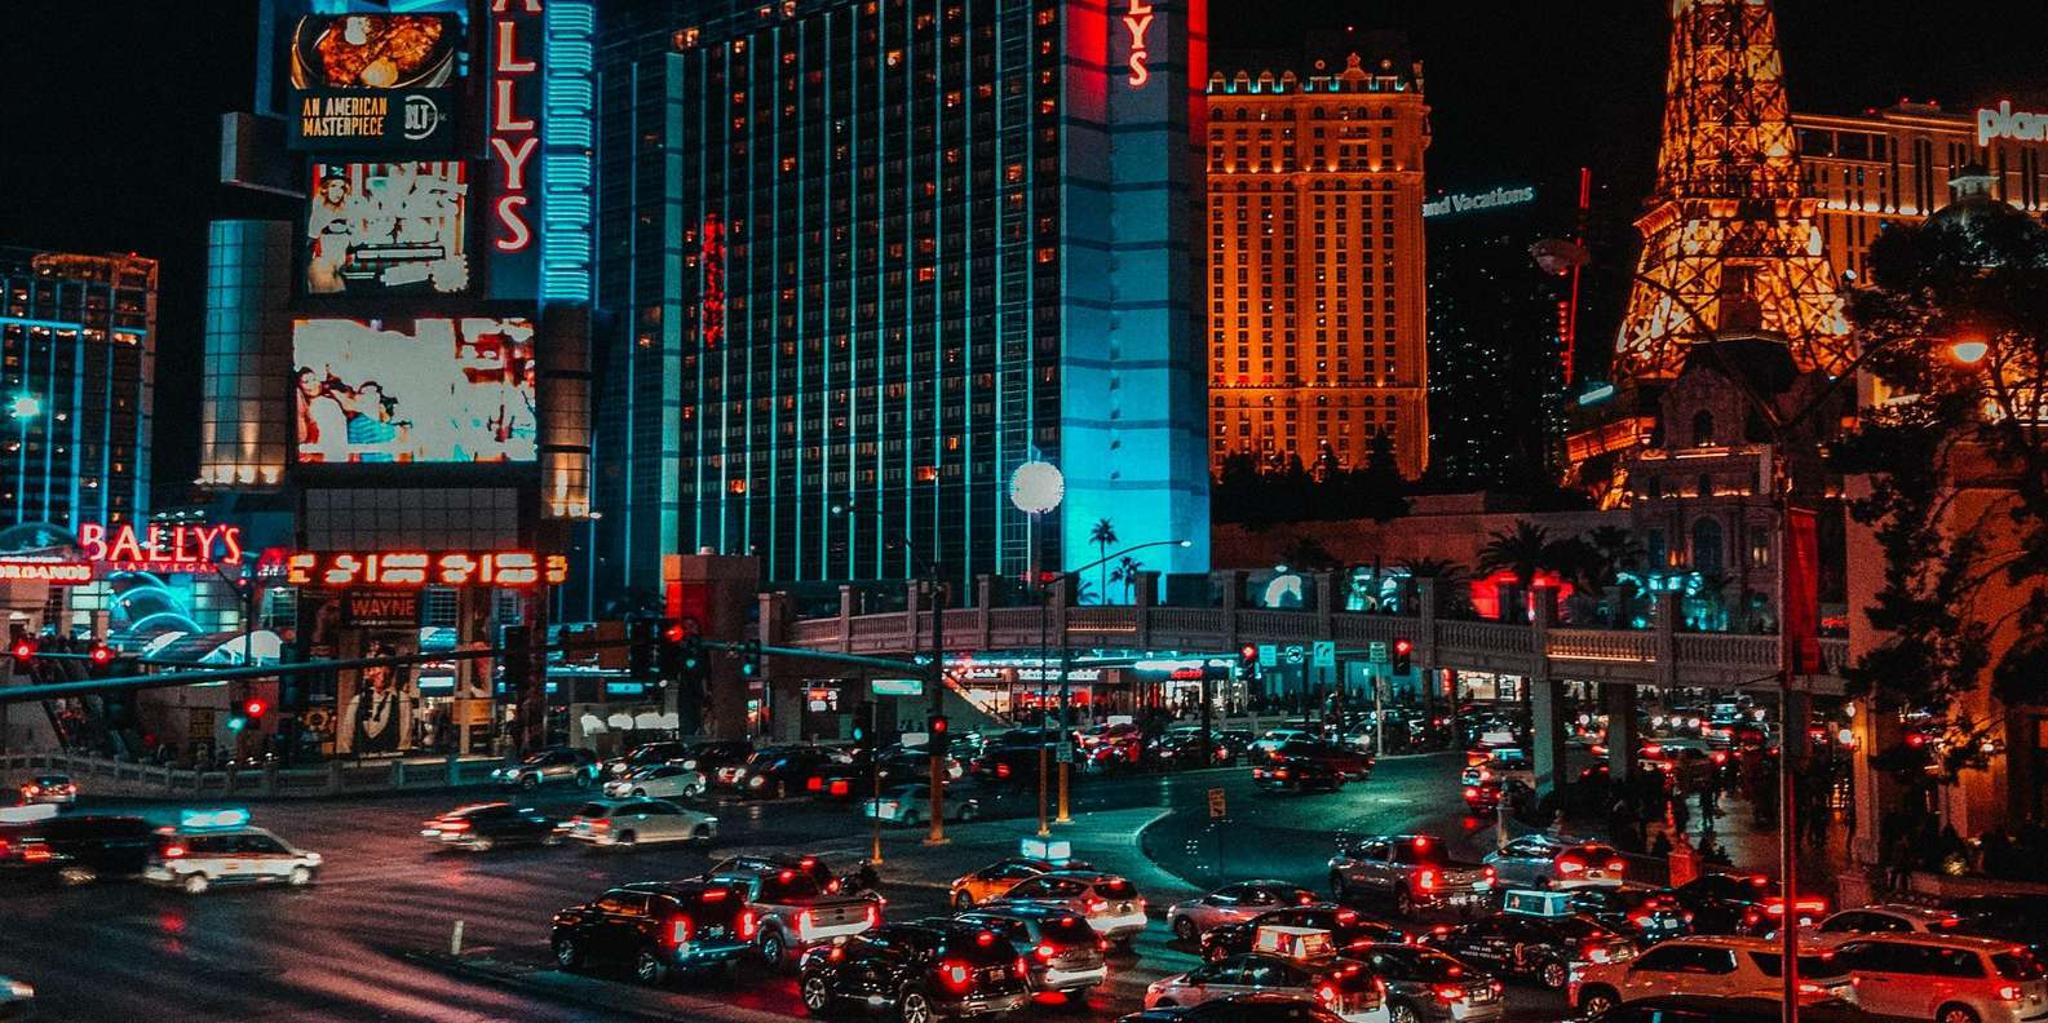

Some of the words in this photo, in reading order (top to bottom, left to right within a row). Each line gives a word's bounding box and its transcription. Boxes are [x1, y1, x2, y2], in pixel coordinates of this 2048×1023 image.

[303, 97, 321, 116] AN
[325, 97, 388, 116] AMERICAN
[303, 116, 385, 136] MASTERPIECE
[491, 0, 543, 250] LLYS
[1452, 187, 1534, 212] Vacations
[80, 524, 242, 564] BALLY'S
[113, 563, 148, 571] LAS
[352, 599, 416, 615] WAYNE
